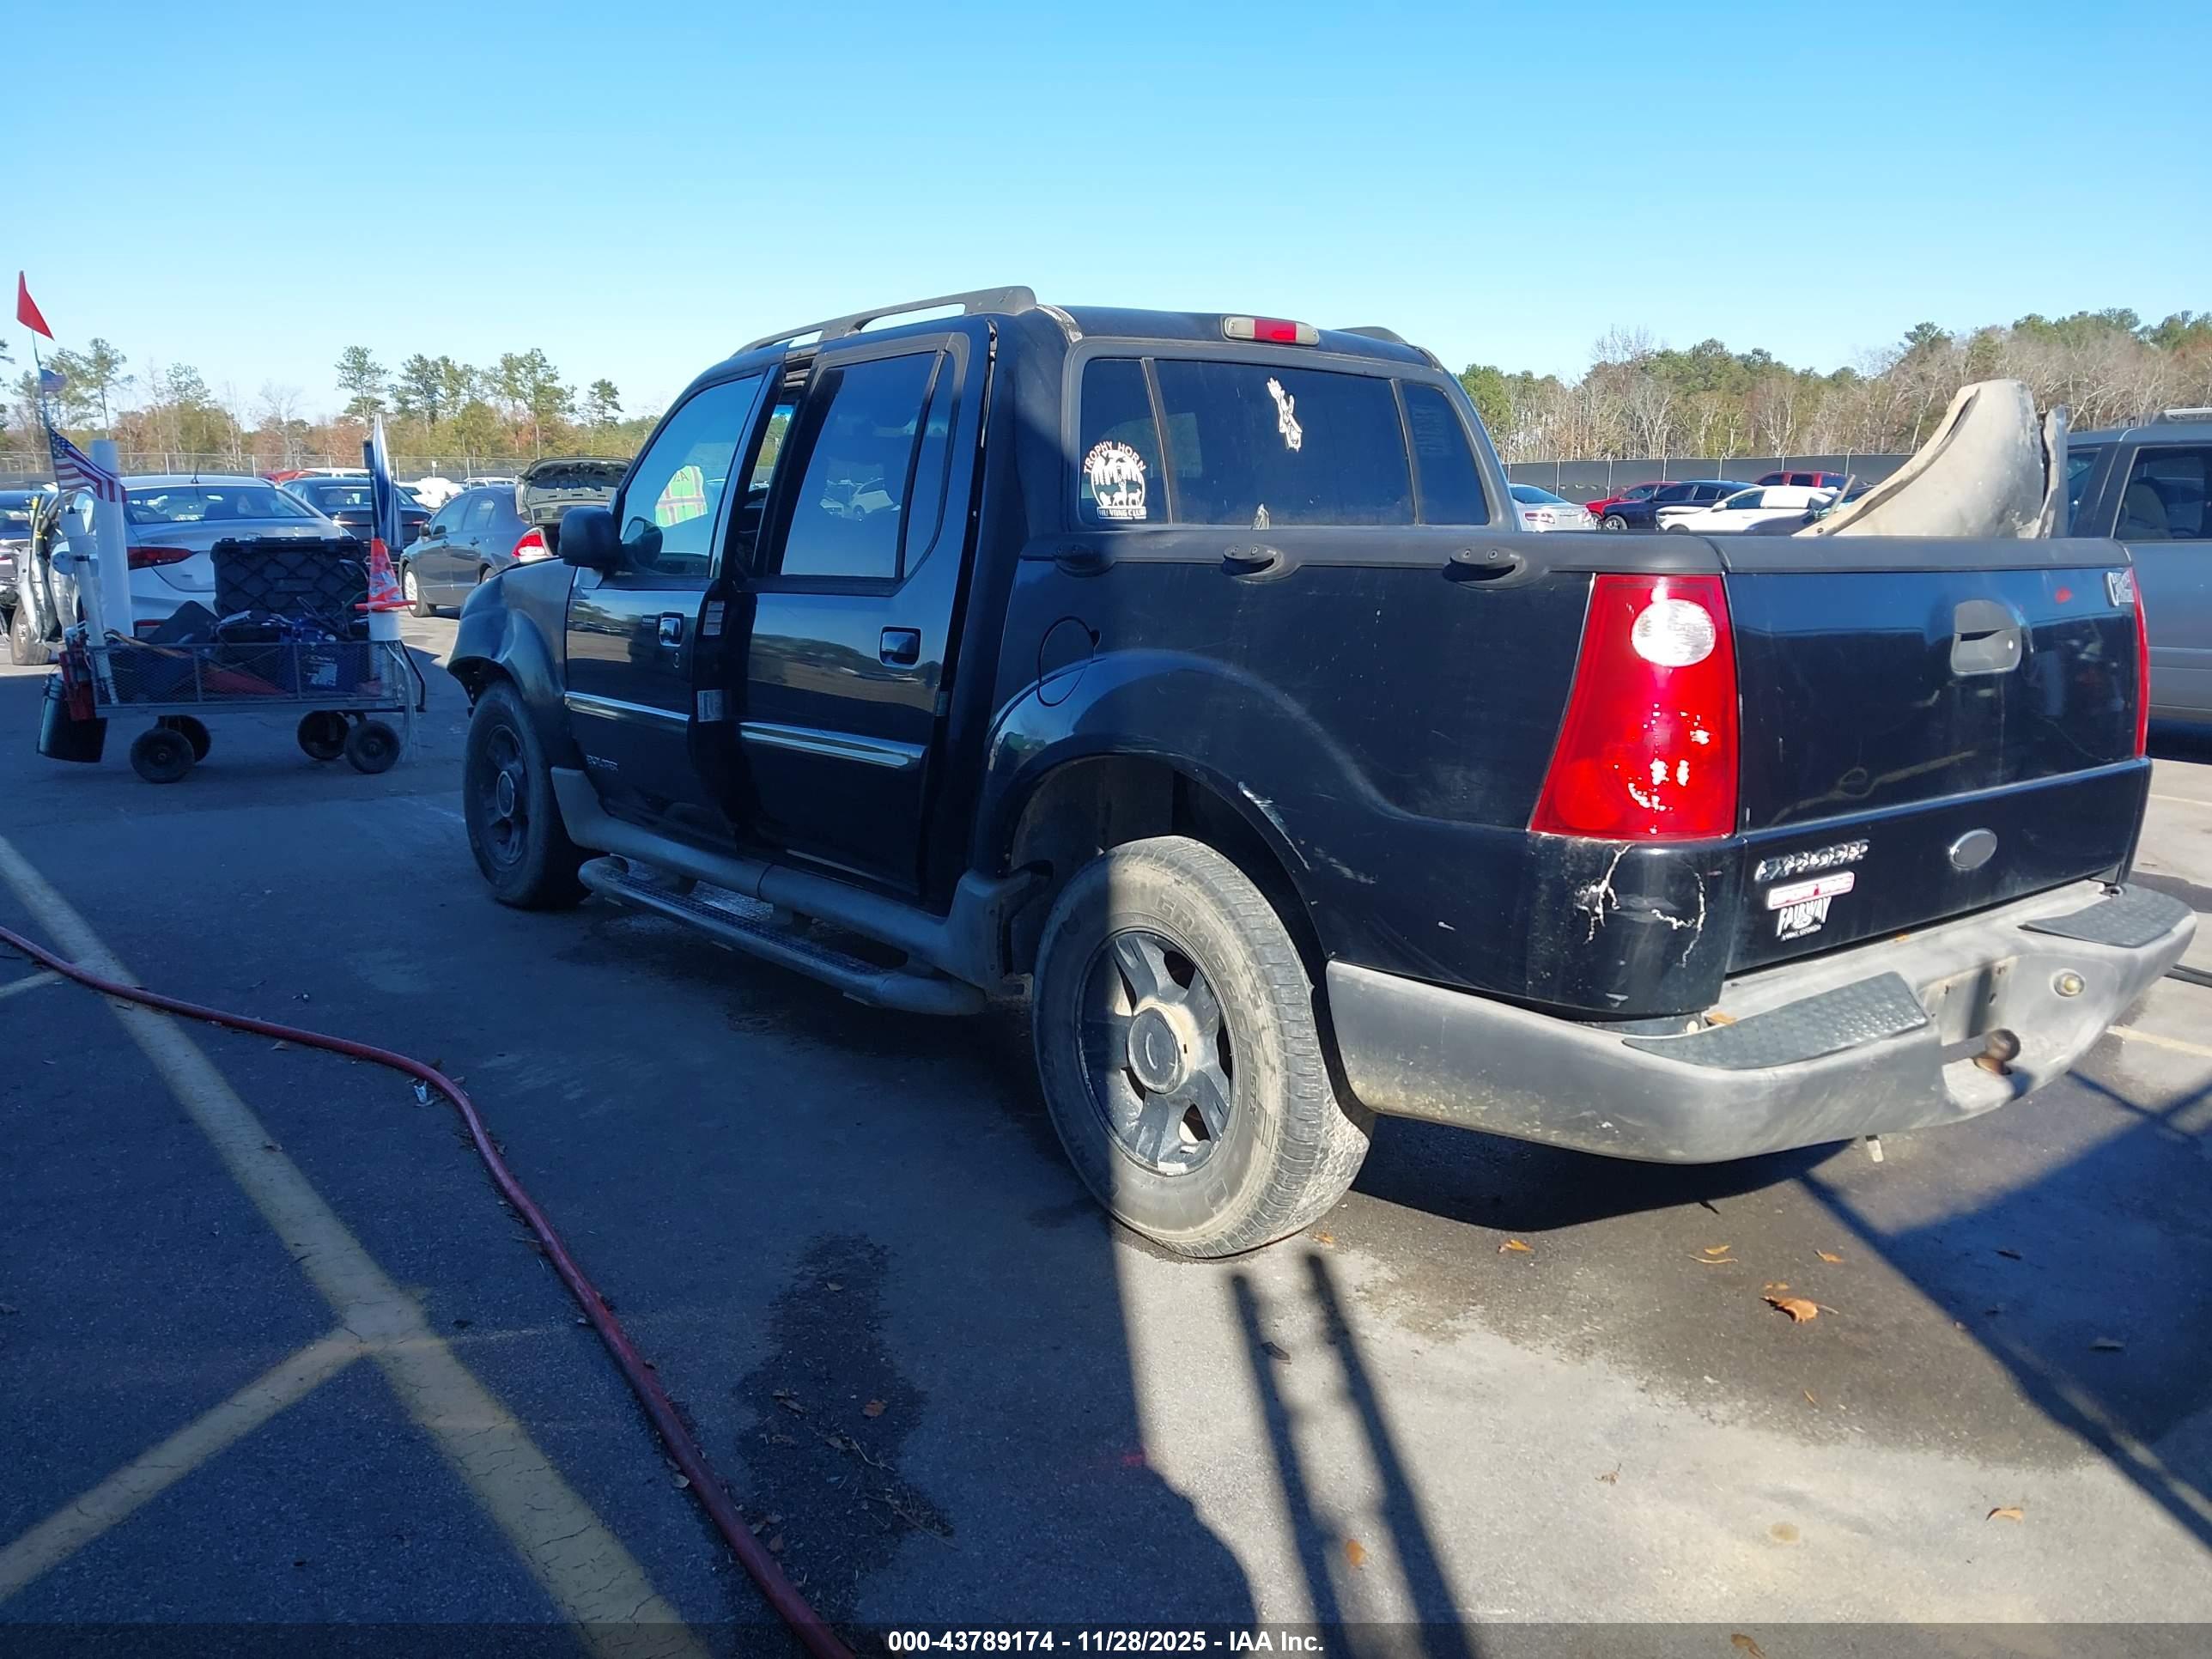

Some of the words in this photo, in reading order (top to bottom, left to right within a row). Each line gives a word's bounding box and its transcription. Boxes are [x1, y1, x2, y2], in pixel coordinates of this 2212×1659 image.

[1084, 441, 1113, 474] TROPHY
[1117, 441, 1147, 471] HORN
[1776, 896, 1832, 937] FAIRWAY
